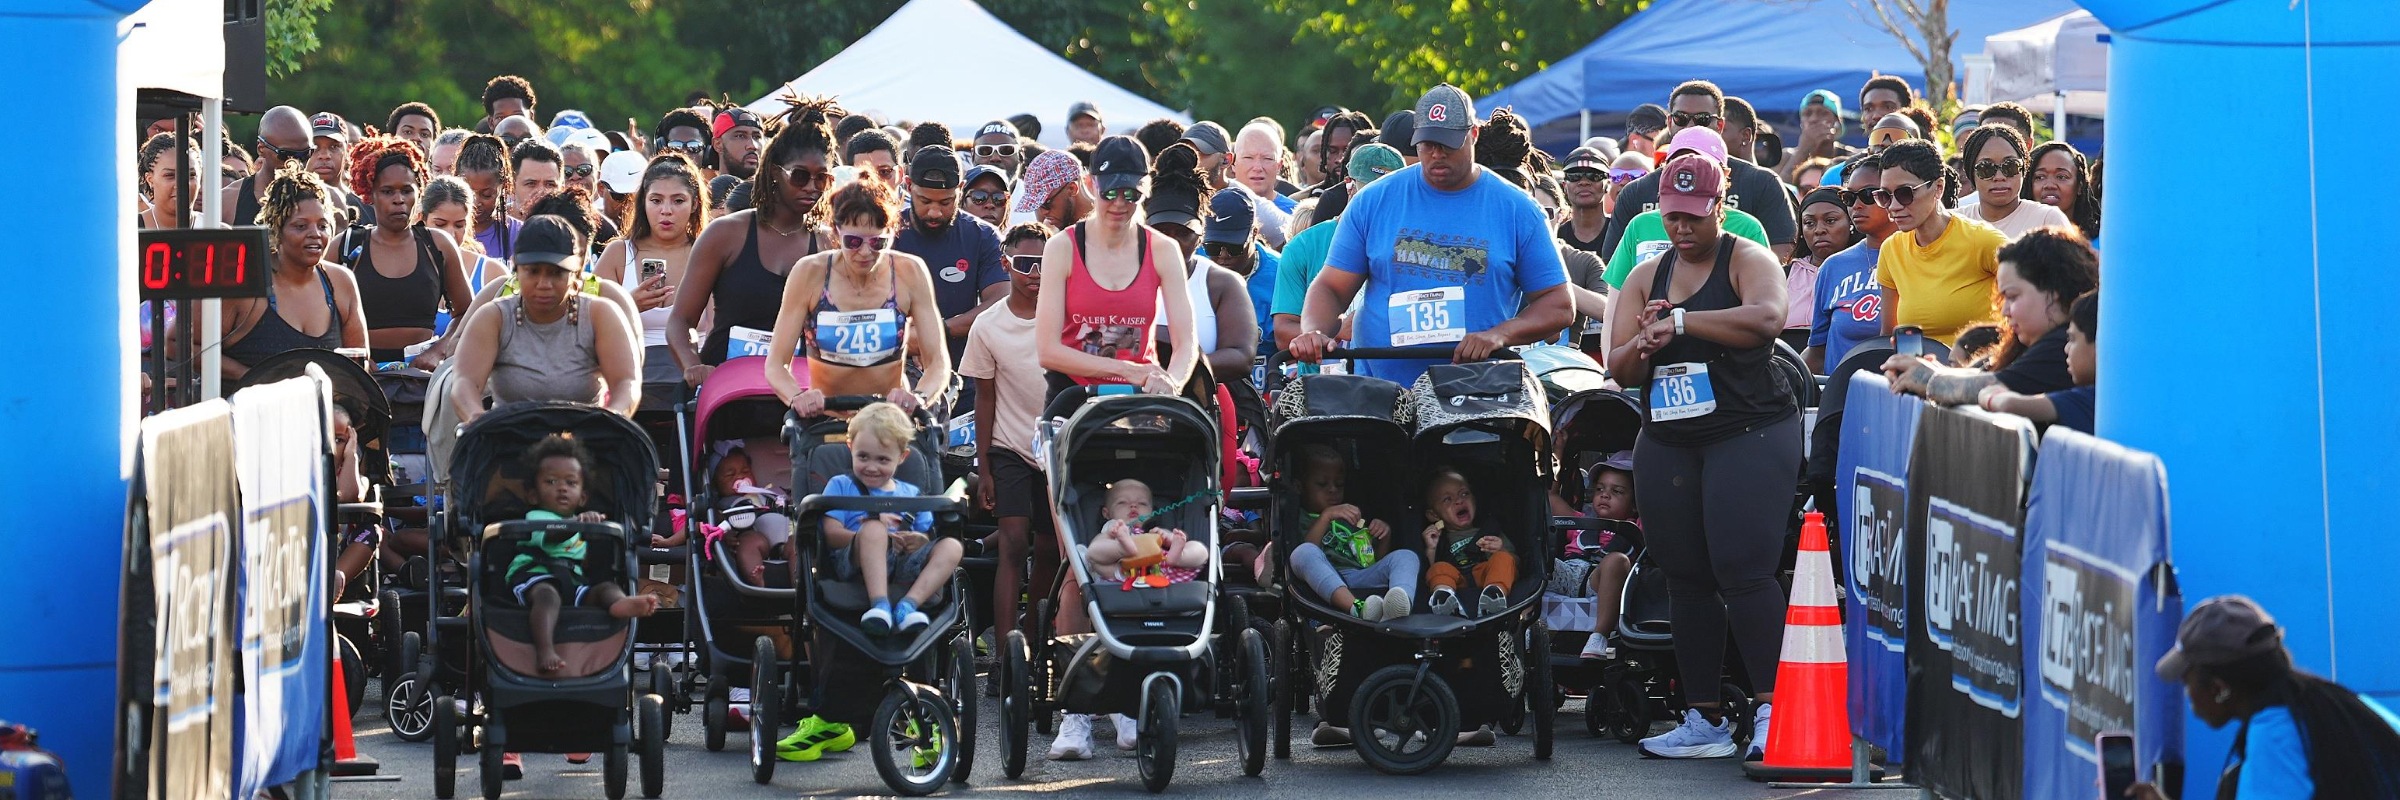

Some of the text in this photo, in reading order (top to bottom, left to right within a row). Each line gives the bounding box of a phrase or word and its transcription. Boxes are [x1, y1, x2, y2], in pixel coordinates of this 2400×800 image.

[144, 242, 246, 289] 0:11
[1396, 249, 1450, 270] HAWAII
[1829, 268, 1882, 310] ATLA
[1072, 313, 1146, 325] CALEB KAISER
[1406, 301, 1449, 332] 135
[834, 323, 881, 354] 243
[1659, 376, 1696, 407] 136
